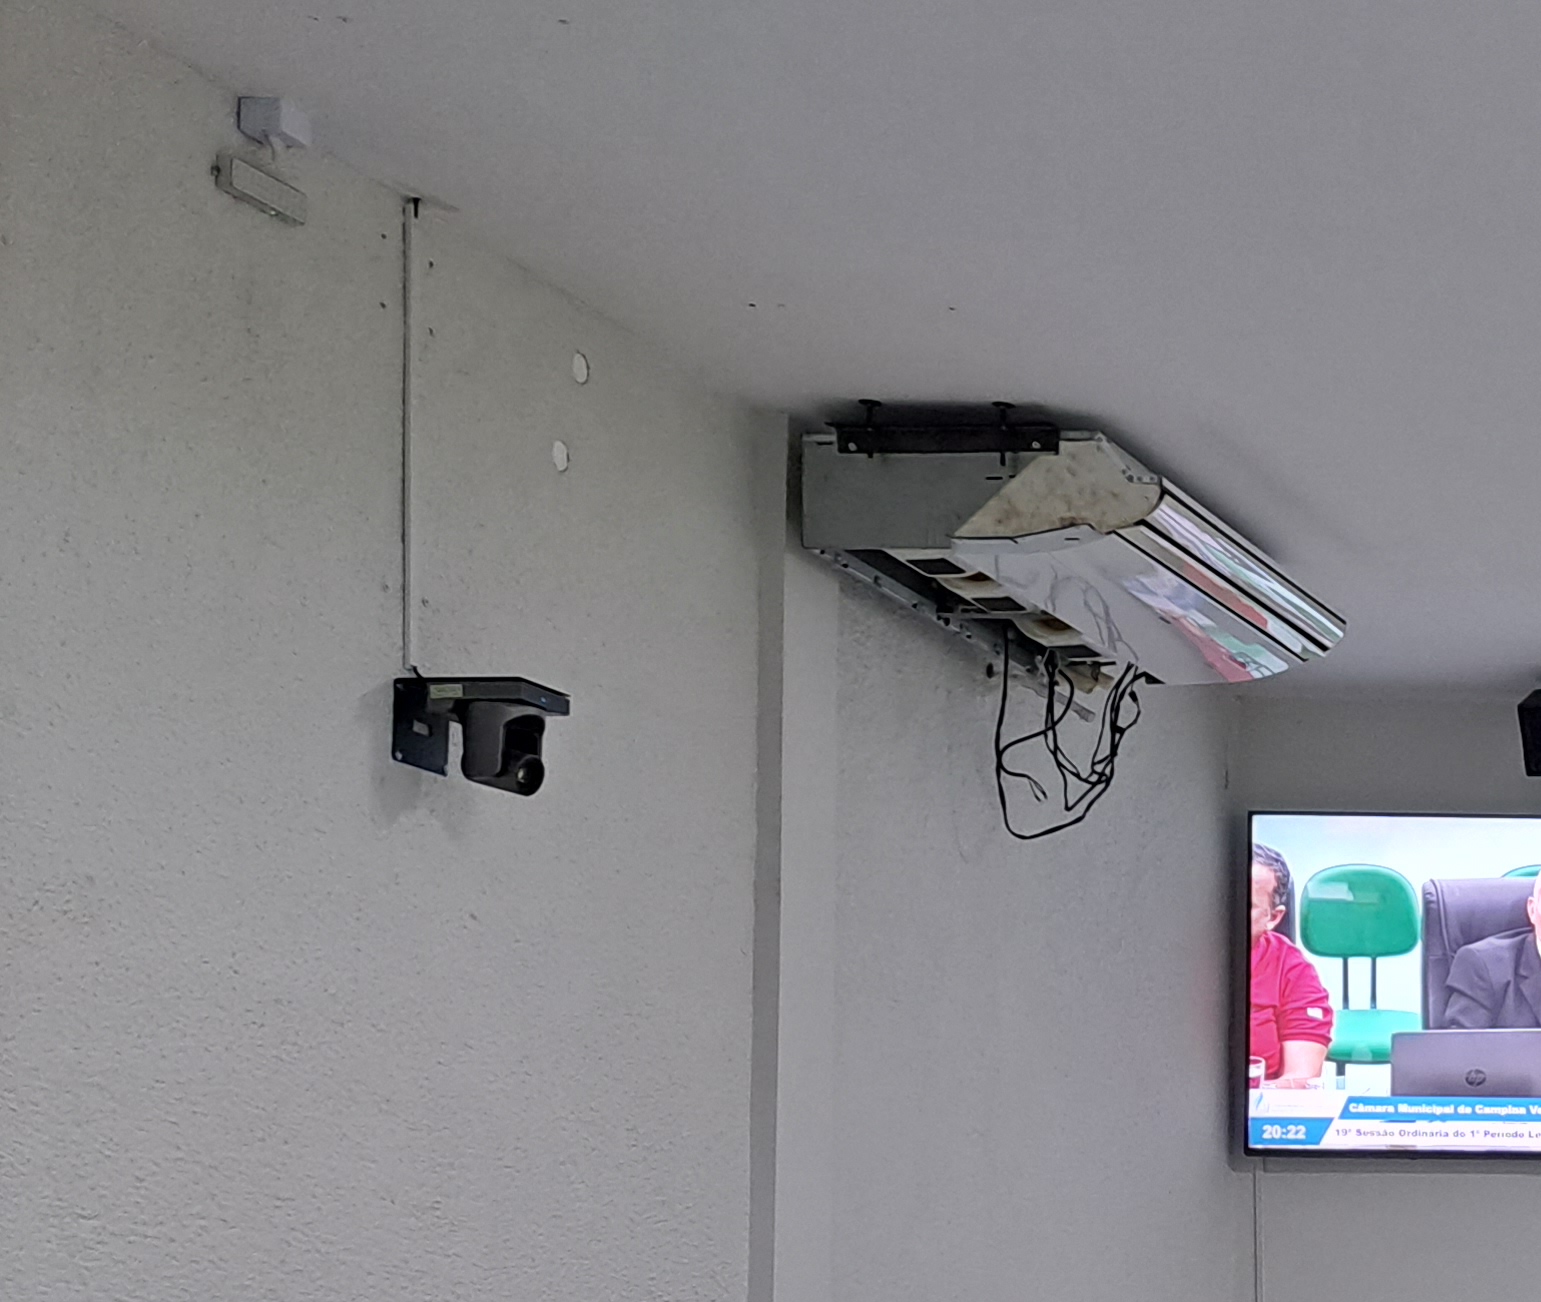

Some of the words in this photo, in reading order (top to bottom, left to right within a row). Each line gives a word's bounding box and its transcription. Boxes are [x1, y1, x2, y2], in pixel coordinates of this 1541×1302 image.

[1397, 1103, 1455, 1116] Municipal
[1474, 1104, 1527, 1116] Campina
[1262, 1124, 1307, 1140] 20:22
